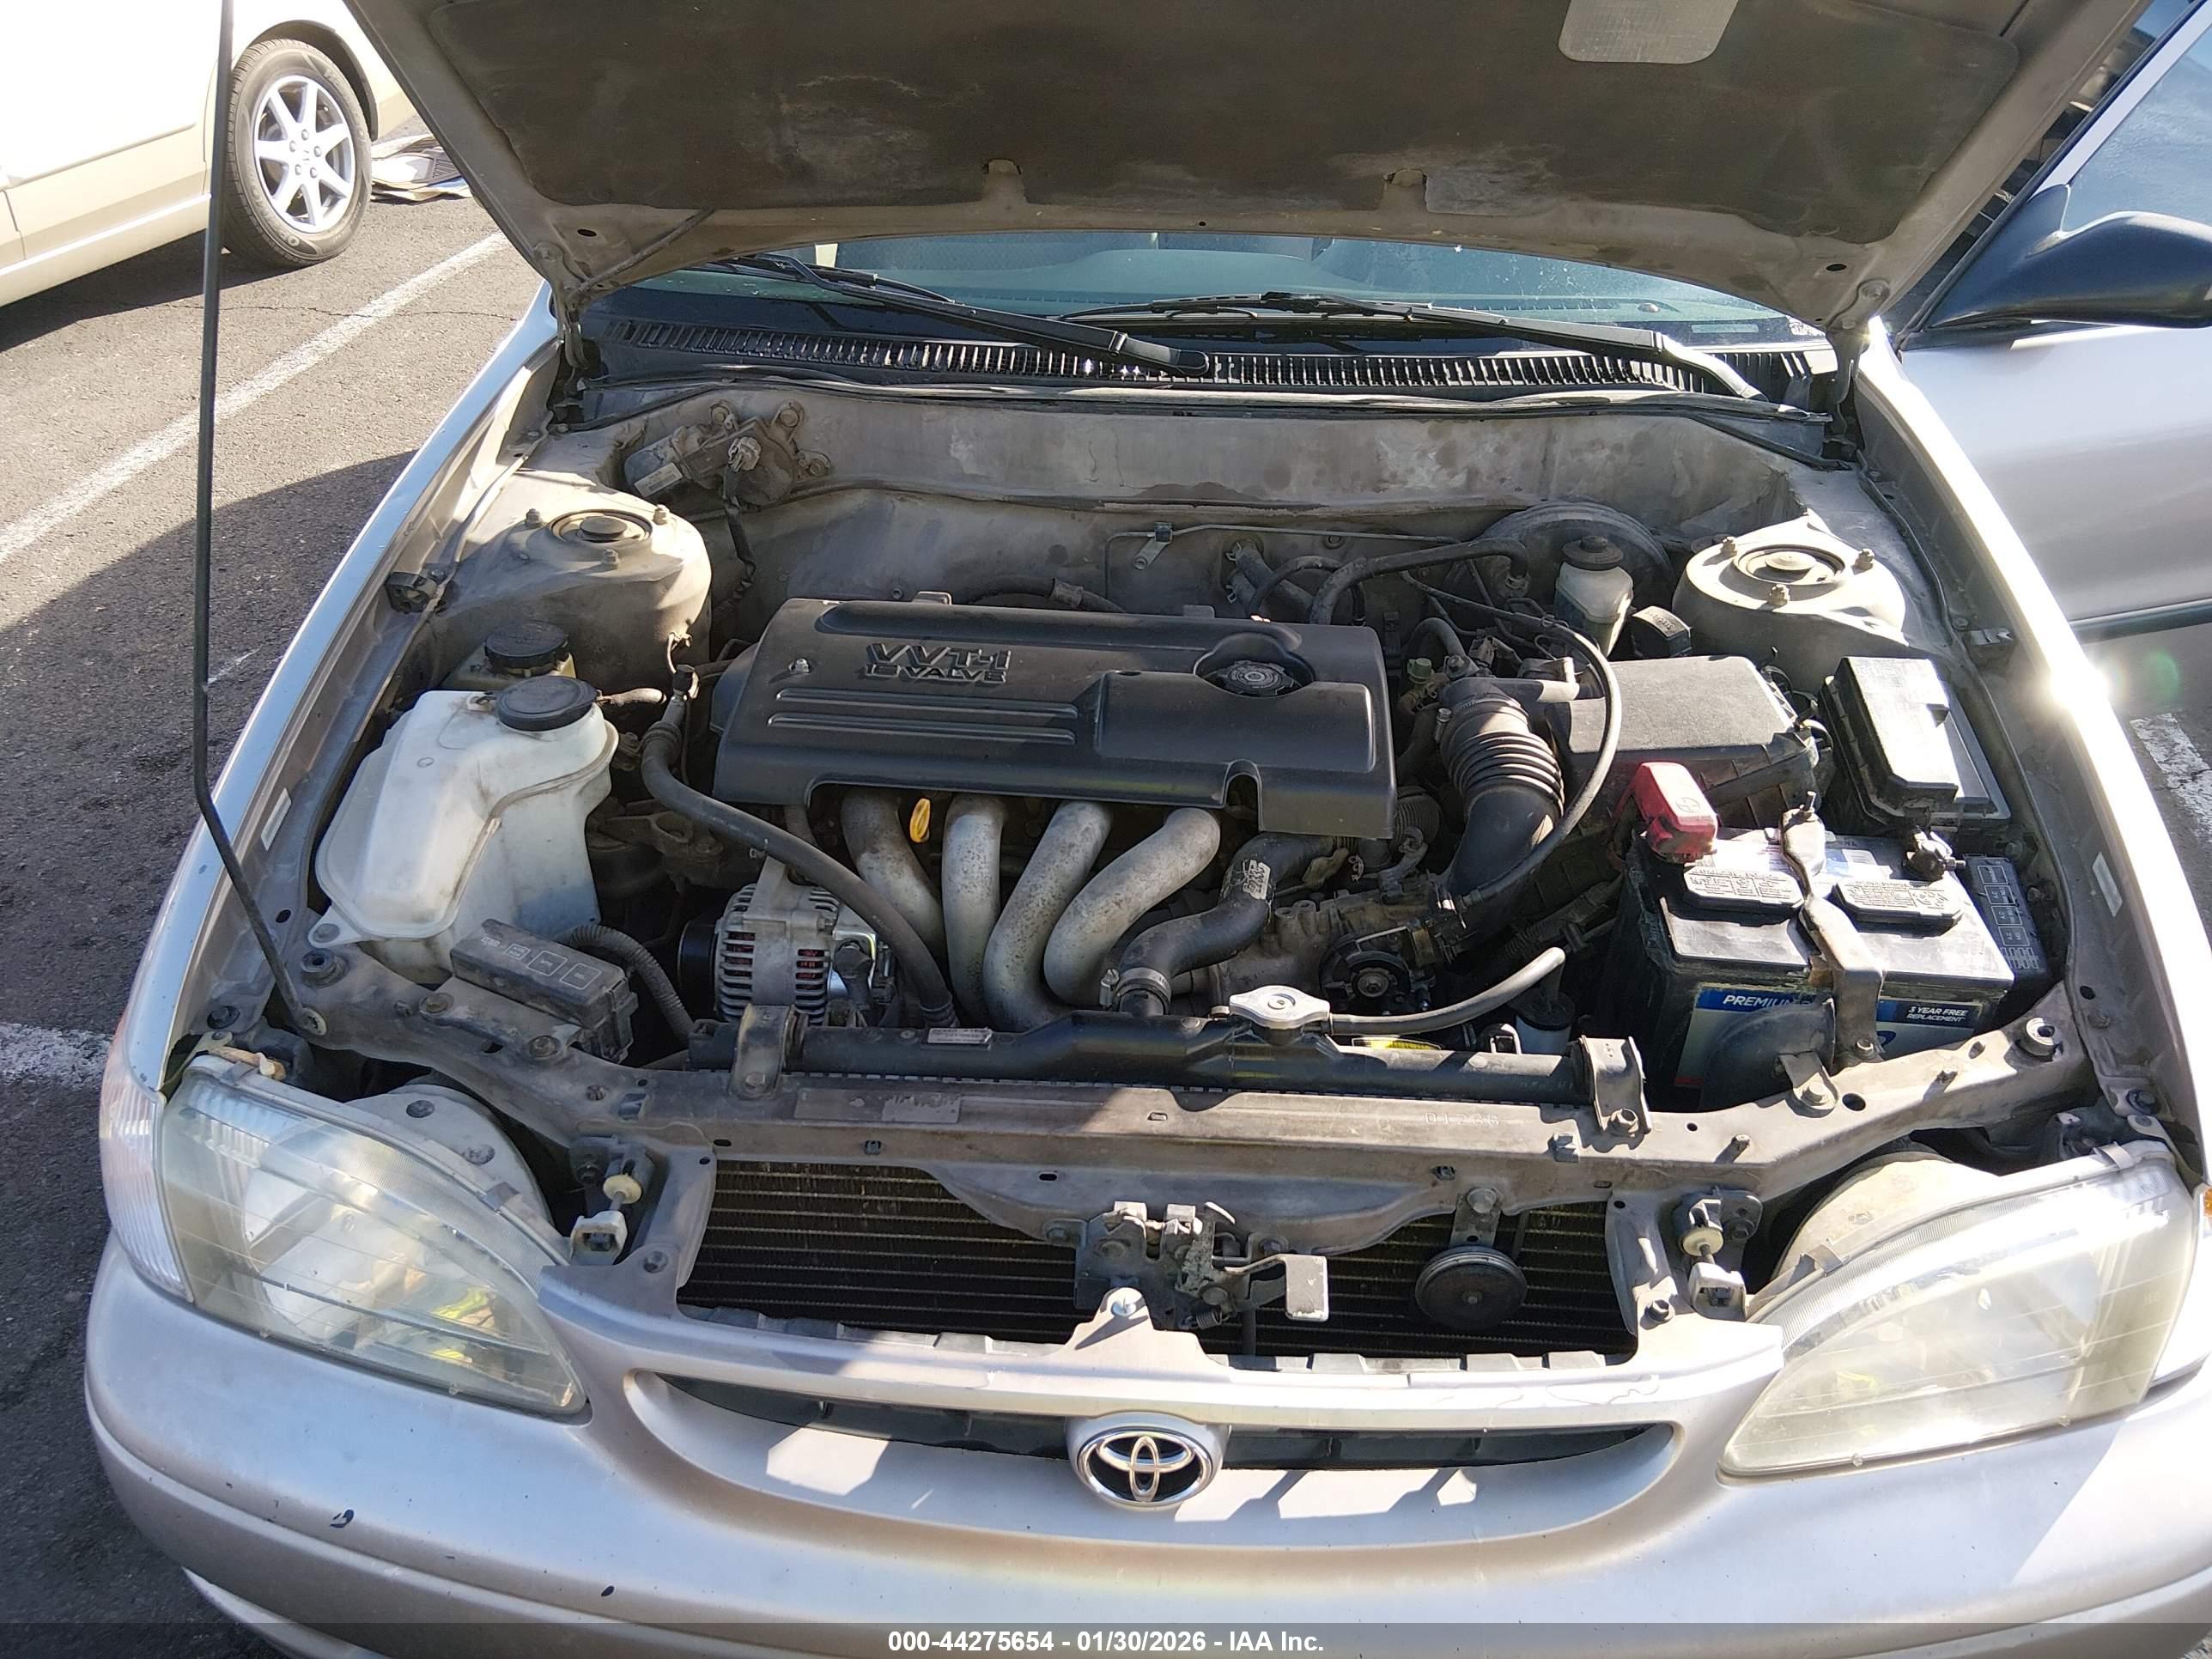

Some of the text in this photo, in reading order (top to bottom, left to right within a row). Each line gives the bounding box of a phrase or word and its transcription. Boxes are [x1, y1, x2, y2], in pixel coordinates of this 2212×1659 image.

[902, 665, 1006, 684] VALVE
[1723, 994, 1793, 1007] PREMIU
[1917, 1006, 1942, 1015] YEAR
[1906, 1013, 1966, 1022] REPLACEMENT
